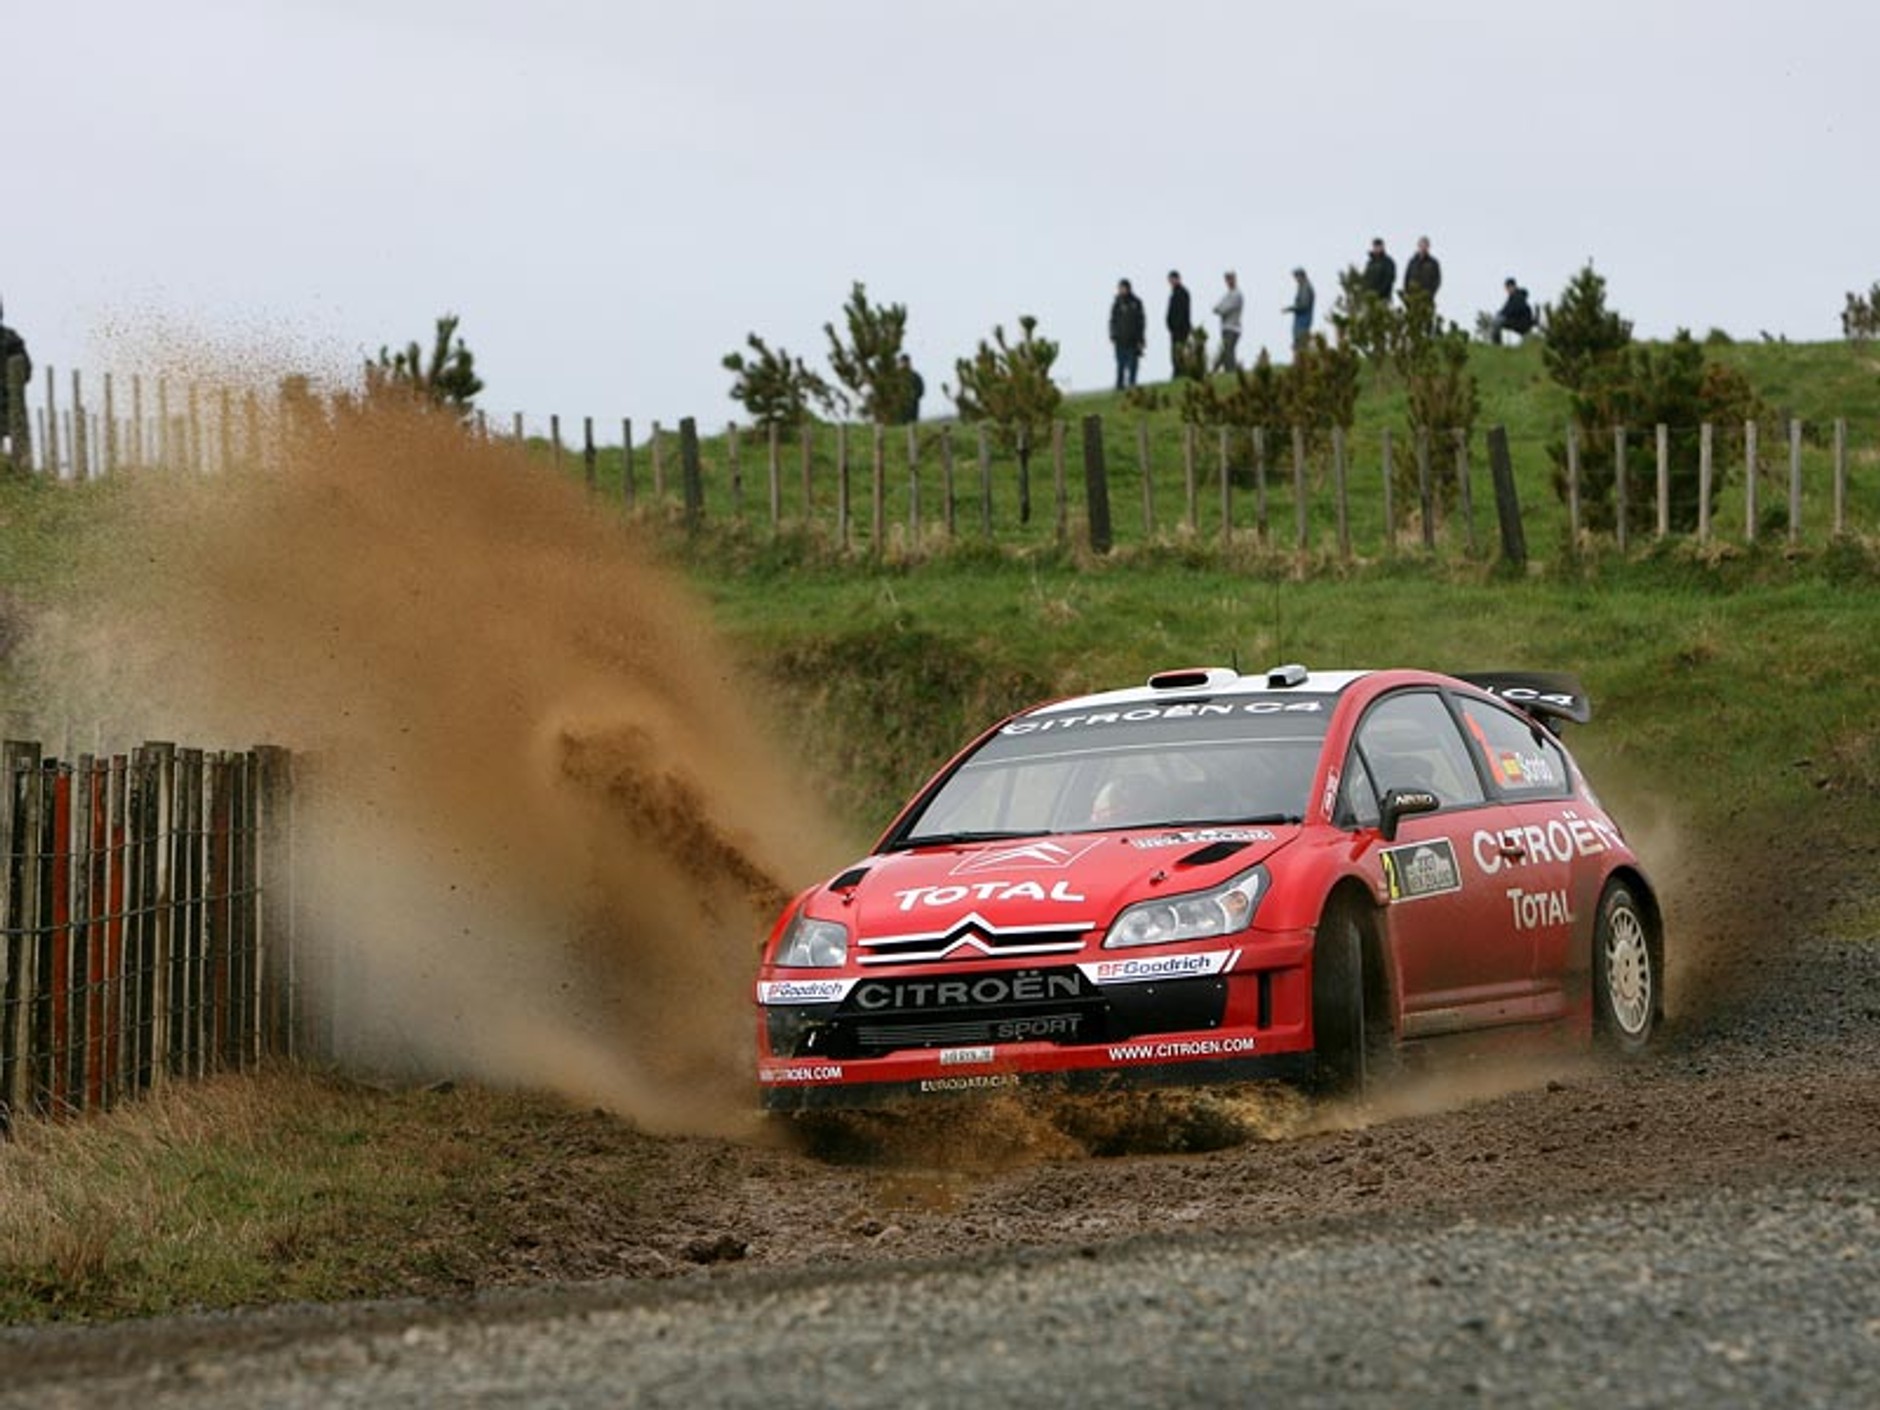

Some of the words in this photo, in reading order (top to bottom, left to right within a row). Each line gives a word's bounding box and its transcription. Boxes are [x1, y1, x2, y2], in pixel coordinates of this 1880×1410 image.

[1501, 688, 1574, 706] C4
[1000, 703, 1233, 735] CITROËN
[1244, 700, 1322, 714] C4
[1473, 810, 1625, 874] CITROËN
[894, 881, 1085, 911] TOTAL
[1506, 888, 1575, 930] TOTAL
[1097, 956, 1211, 977] BFGoodrich
[856, 970, 1081, 1009] CITROËN
[997, 1017, 1081, 1039] SPORT
[1109, 1037, 1255, 1061] WWW.CITROEN.COM
